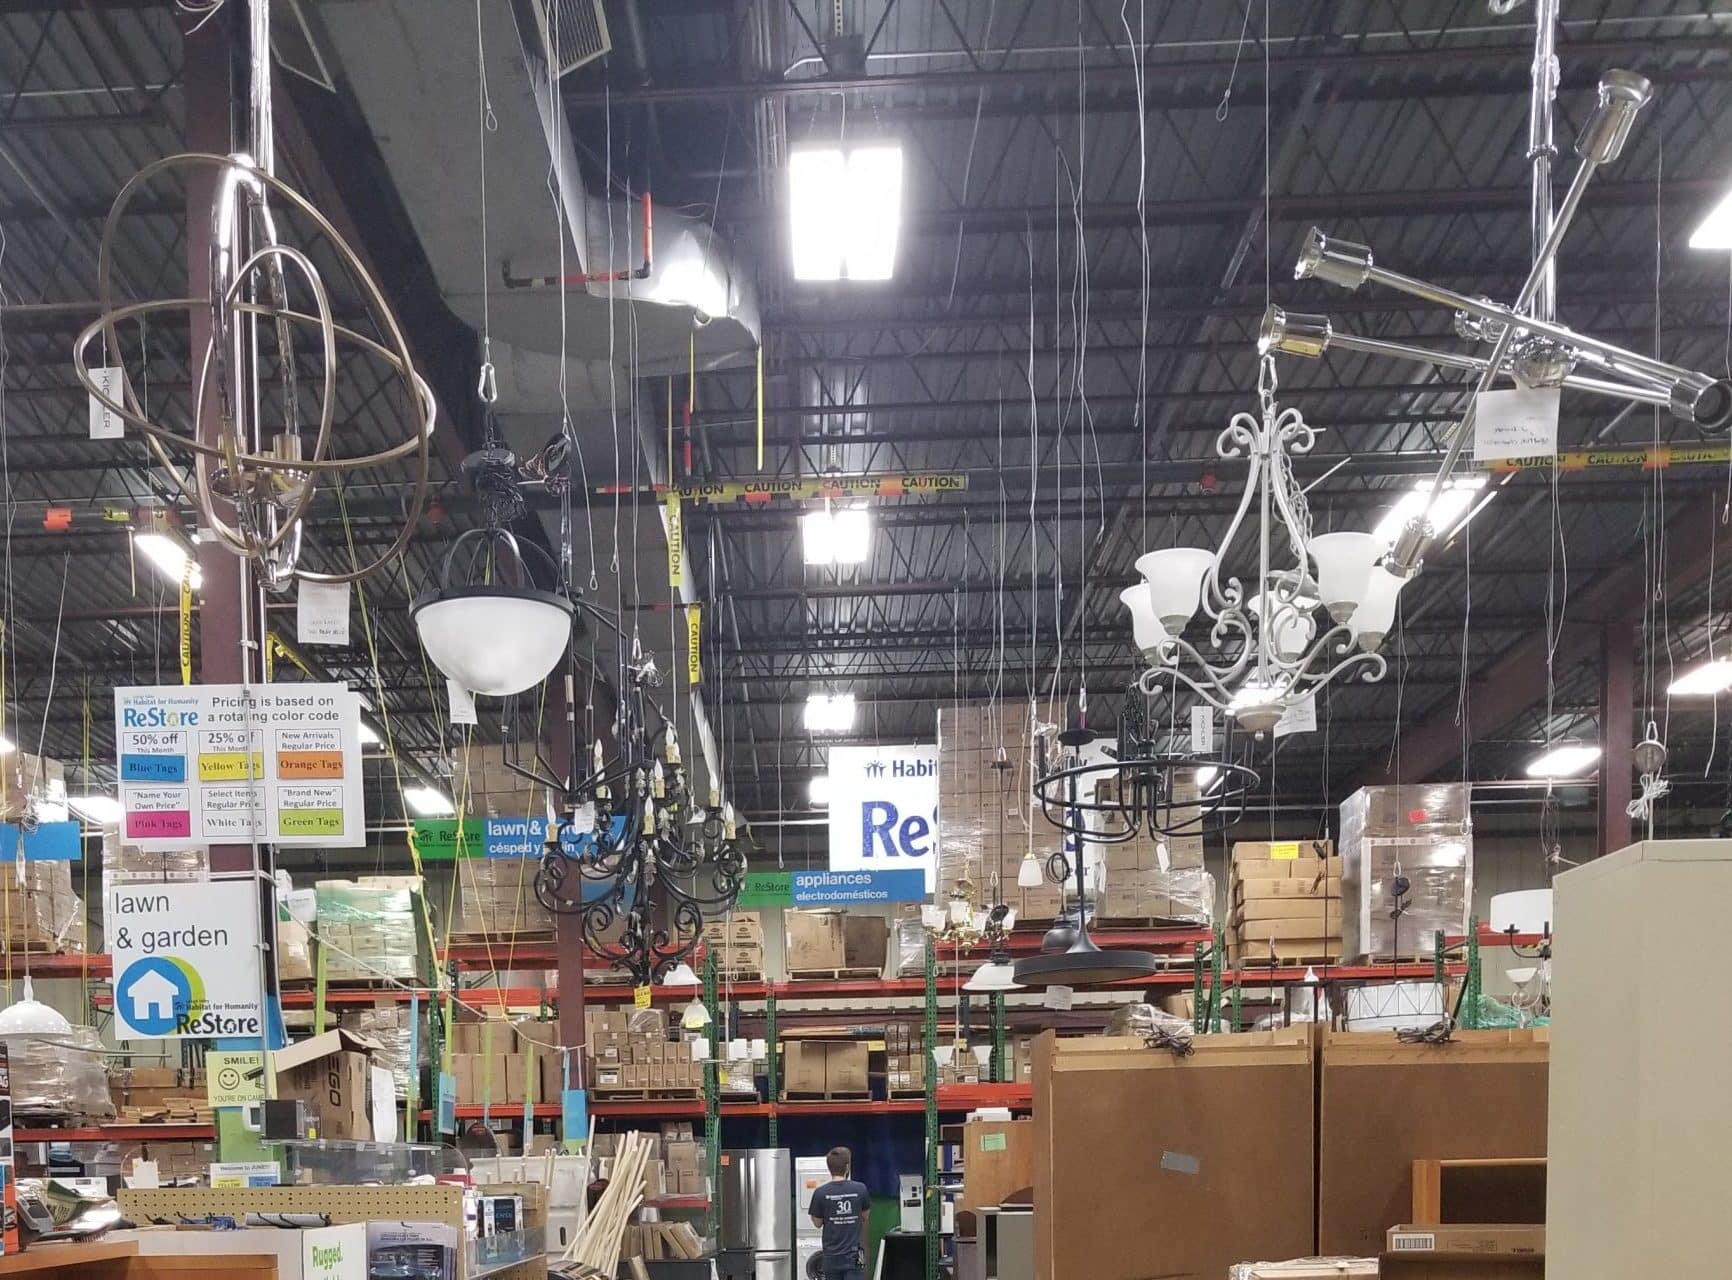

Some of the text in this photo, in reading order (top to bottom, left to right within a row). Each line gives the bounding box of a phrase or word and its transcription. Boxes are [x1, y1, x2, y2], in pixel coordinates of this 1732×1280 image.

[102, 376, 111, 429] KICER
[1588, 453, 1648, 464] CAUION
[745, 481, 802, 492] CAUTION
[823, 478, 880, 489] CAUTION
[901, 477, 960, 488] CAUTION
[670, 515, 681, 576] CAUTION
[182, 613, 190, 667] CAUTION
[690, 623, 698, 672] CAUTION
[261, 696, 271, 706] is
[276, 696, 314, 706] based
[318, 697, 334, 706] on
[124, 707, 198, 727] ReStore
[208, 710, 339, 723] a rotang color code
[133, 733, 178, 745] 50% off
[208, 732, 254, 743] 25% of
[302, 731, 334, 739] Arrivals
[129, 763, 178, 774] Blue Tags
[201, 762, 233, 771] Yellow
[280, 760, 343, 770] Orange Tags
[207, 801, 238, 809] Regular
[283, 800, 315, 808] Regular
[135, 820, 183, 829] Pink Tags
[206, 819, 237, 827] White
[283, 817, 340, 827] Green Tags
[488, 820, 526, 836] lawn
[529, 820, 542, 836] &
[862, 801, 937, 857] Re
[796, 872, 872, 888] appliances
[754, 881, 790, 892] ReStore
[796, 889, 888, 901] electrodomésticos
[115, 892, 169, 914] lawn
[116, 925, 228, 954] & garden
[213, 1002, 223, 1010] for
[225, 1002, 258, 1011] Humanity
[176, 1012, 258, 1034] ReStore
[224, 1056, 259, 1065] SMILE!
[836, 1200, 852, 1213] 30
[312, 1242, 343, 1270] Rugged.
